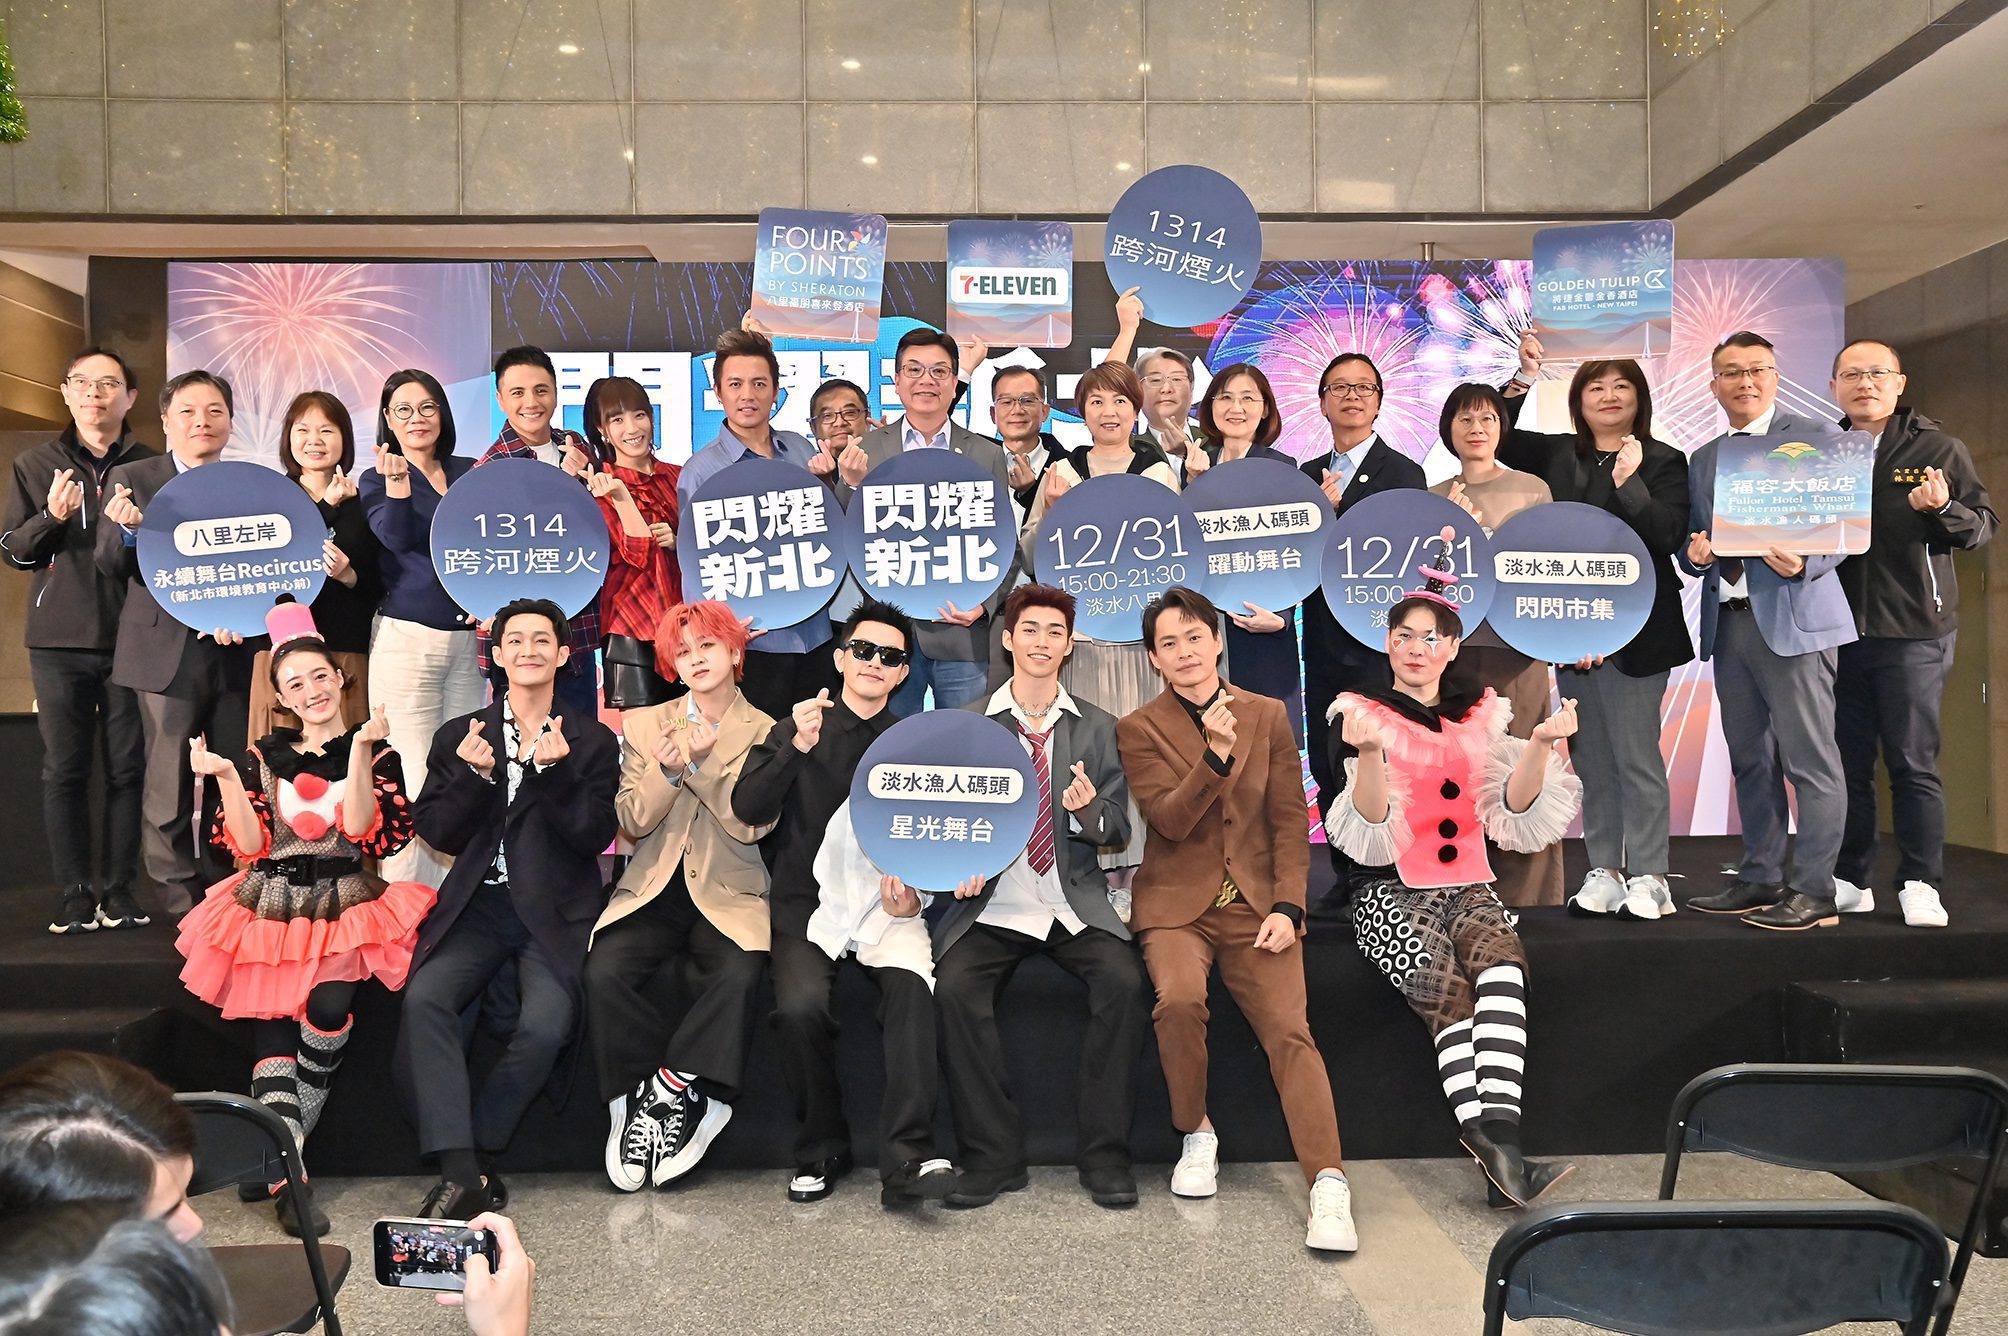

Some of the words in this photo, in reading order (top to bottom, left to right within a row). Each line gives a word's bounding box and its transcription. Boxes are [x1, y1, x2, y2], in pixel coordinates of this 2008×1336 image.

[772, 225, 846, 253] FOUR
[1149, 210, 1226, 249] 1314
[769, 251, 868, 280] POINTS
[1109, 234, 1245, 292] 跨河煙火
[768, 280, 786, 291] BY
[791, 281, 865, 297] SHERATON
[1537, 278, 1596, 292] GOLDEN
[1599, 276, 1640, 289] TULIP
[767, 295, 865, 313] 八里福朋喜來登酒店
[1567, 303, 1591, 311] HOTEL
[1730, 475, 1857, 495] 福容大飯店
[862, 480, 996, 534] 閃耀
[1727, 503, 1808, 514] Fisherman's
[1812, 502, 1857, 512] Wharf
[1728, 496, 1764, 506] Fullon
[1772, 495, 1803, 504] Hotel
[1811, 493, 1855, 503] Tamsui
[473, 513, 568, 538] 1314
[691, 485, 829, 550] 閃耀
[1744, 514, 1838, 526] 淡水漁人碼頭
[191, 521, 278, 548] 八里左岸
[1048, 514, 1189, 570] 12/31
[443, 546, 601, 576] 跨河煙火
[698, 540, 836, 602] 新北
[863, 534, 1000, 588] 新北
[1207, 546, 1302, 575] 躍動舞台
[1504, 557, 1627, 579] 淡水漁人碼頭
[1058, 563, 1186, 594] 15:00-21:30
[1515, 596, 1615, 621] 閃閃市集
[881, 771, 1010, 796] 淡水漁人碼頭
[889, 814, 994, 844] 星光舞台
